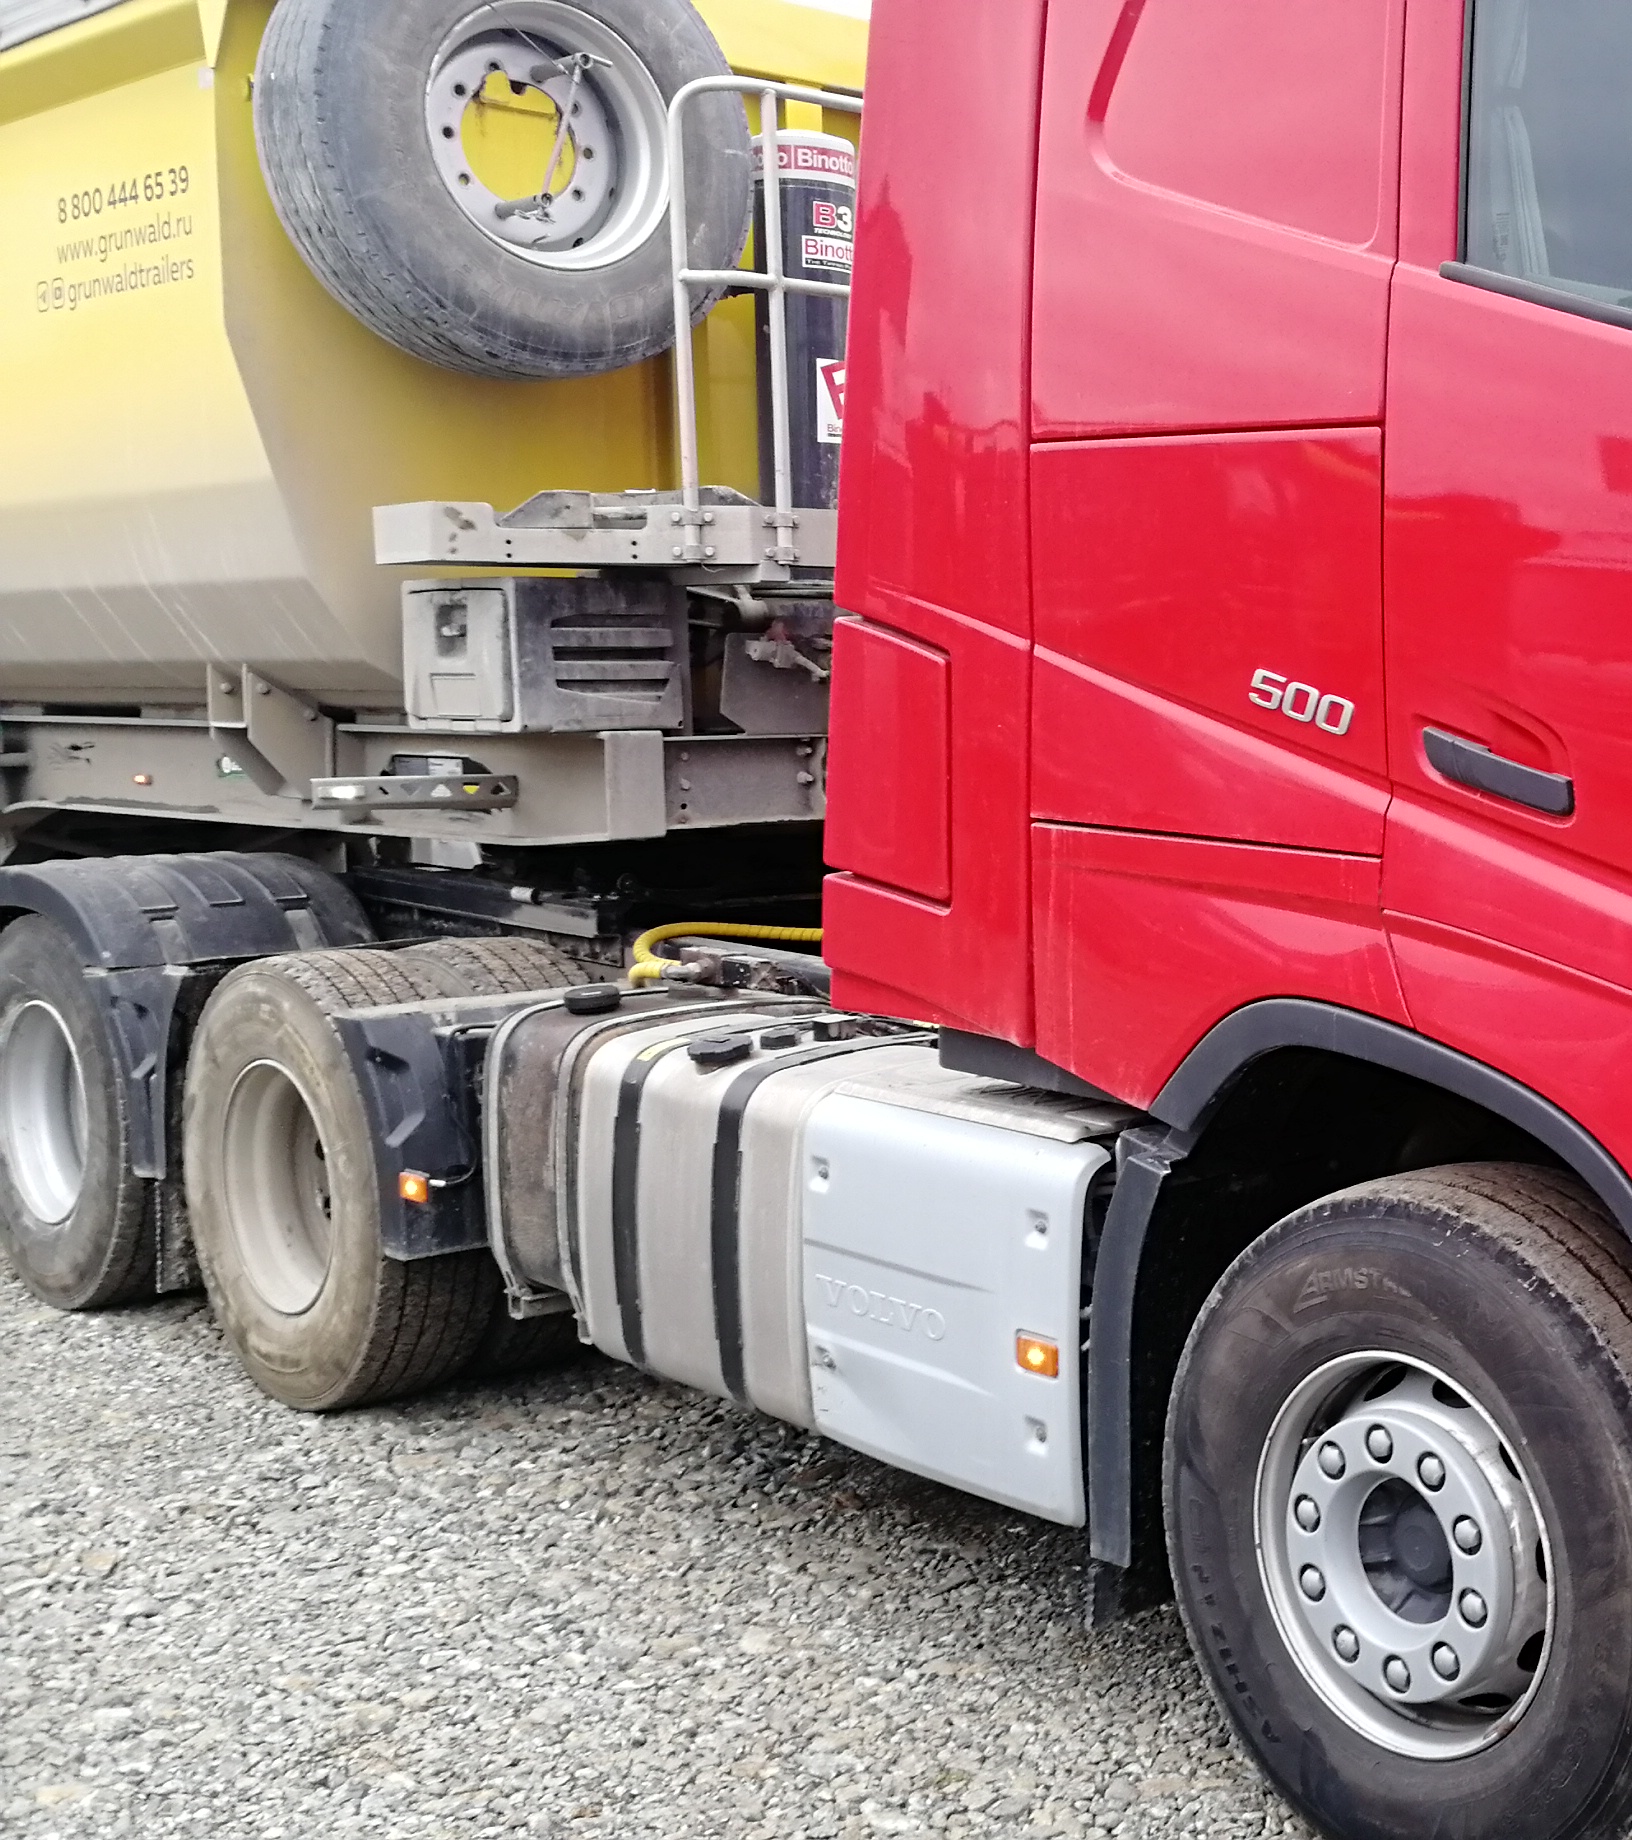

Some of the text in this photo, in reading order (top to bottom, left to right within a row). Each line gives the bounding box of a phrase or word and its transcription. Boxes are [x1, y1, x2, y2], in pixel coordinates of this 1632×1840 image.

[797, 148, 853, 174] Binotto
[57, 165, 189, 224] 8 800 444 65 39
[813, 201, 852, 232] B3
[56, 211, 193, 264] www.grunwald.ru
[805, 238, 853, 262] Binott
[67, 254, 195, 311] grunwaldtrailers
[1248, 668, 1355, 736] 500
[815, 1273, 946, 1341] VOLVO
